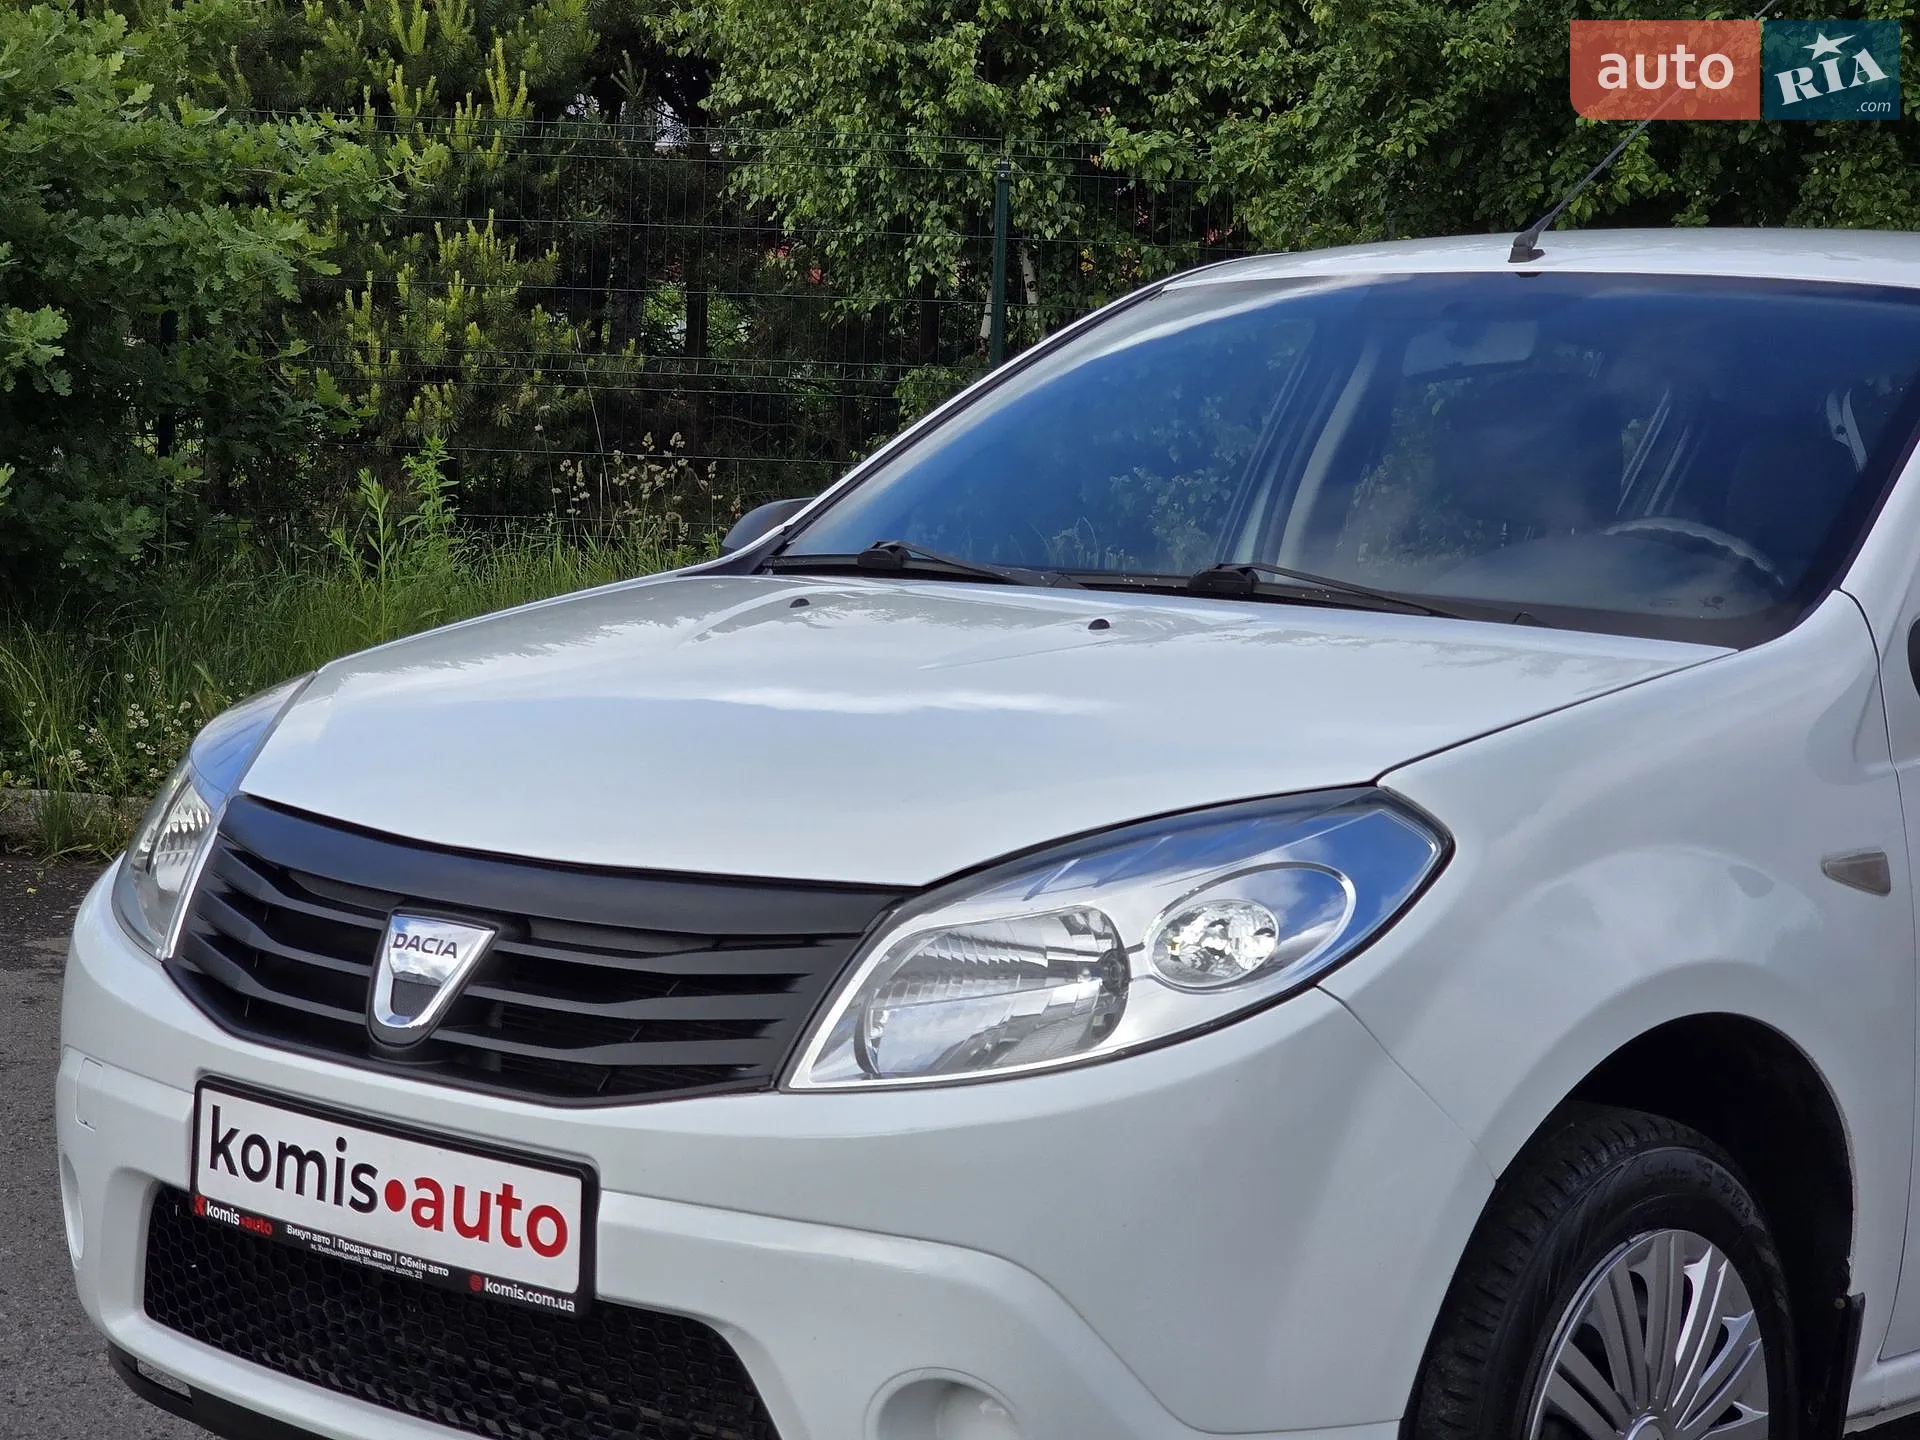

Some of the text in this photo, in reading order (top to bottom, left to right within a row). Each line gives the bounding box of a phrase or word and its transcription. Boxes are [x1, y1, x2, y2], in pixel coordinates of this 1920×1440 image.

[391, 932, 458, 959] DACIA
[286, 1224, 449, 1277] Викуп авто Продаж авто Обмін авто
[484, 1277, 576, 1313] komis.com.ua
